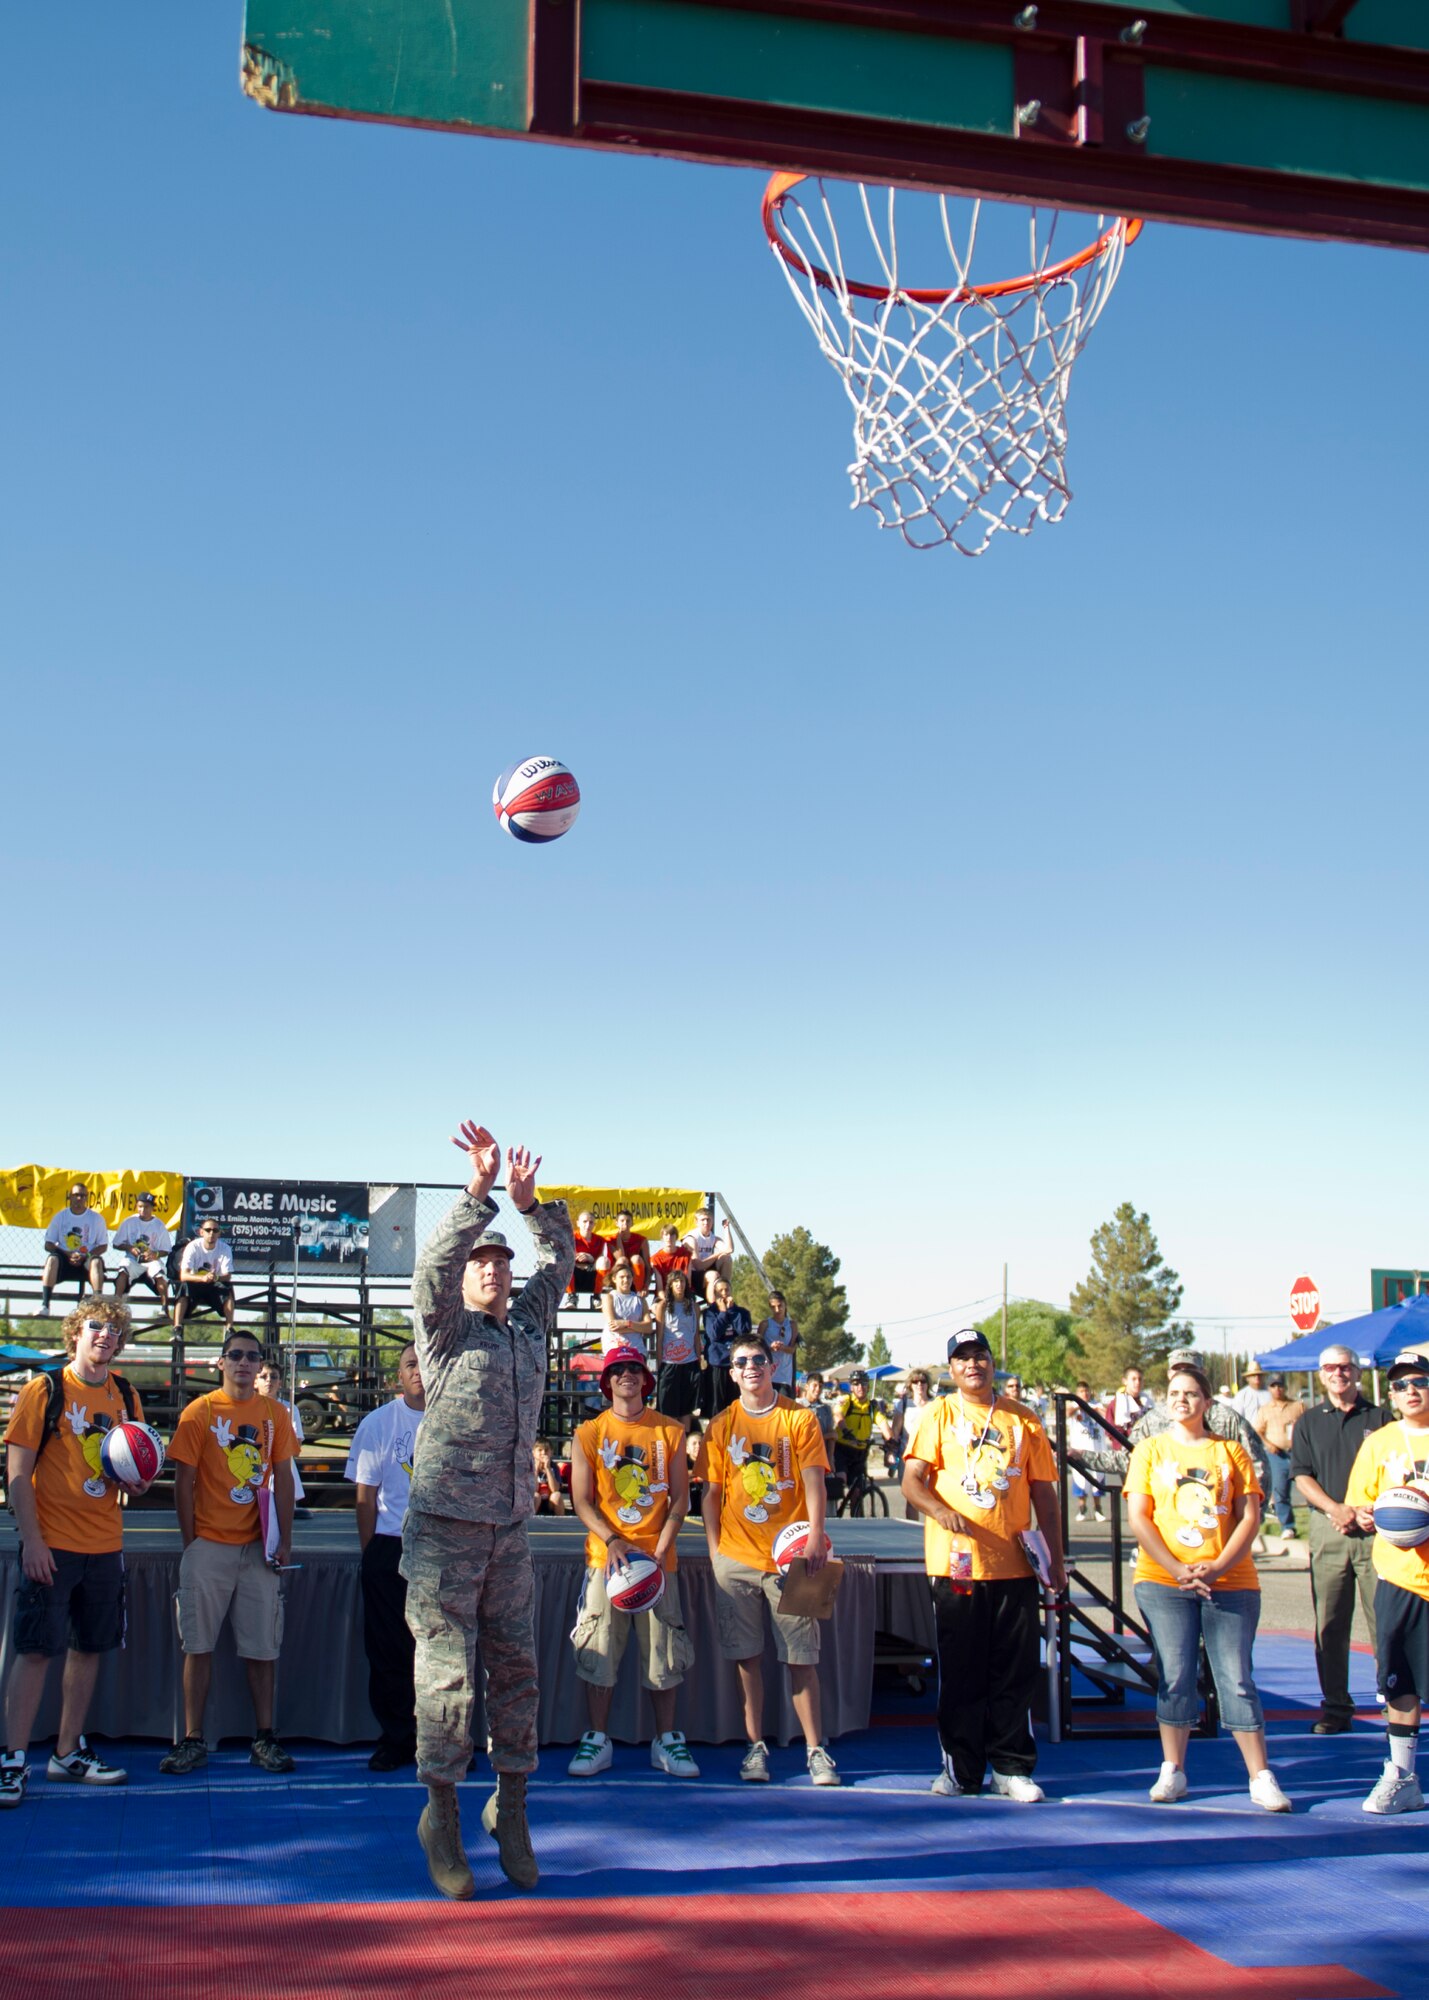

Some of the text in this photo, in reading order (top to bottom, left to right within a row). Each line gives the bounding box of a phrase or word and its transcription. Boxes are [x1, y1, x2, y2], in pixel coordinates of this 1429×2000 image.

[234, 1192, 337, 1212] A&E Music
[593, 1202, 689, 1219] QUALITY PAINT & BODY
[227, 1215, 248, 1223] Emilio
[1290, 1291, 1319, 1316] STOP
